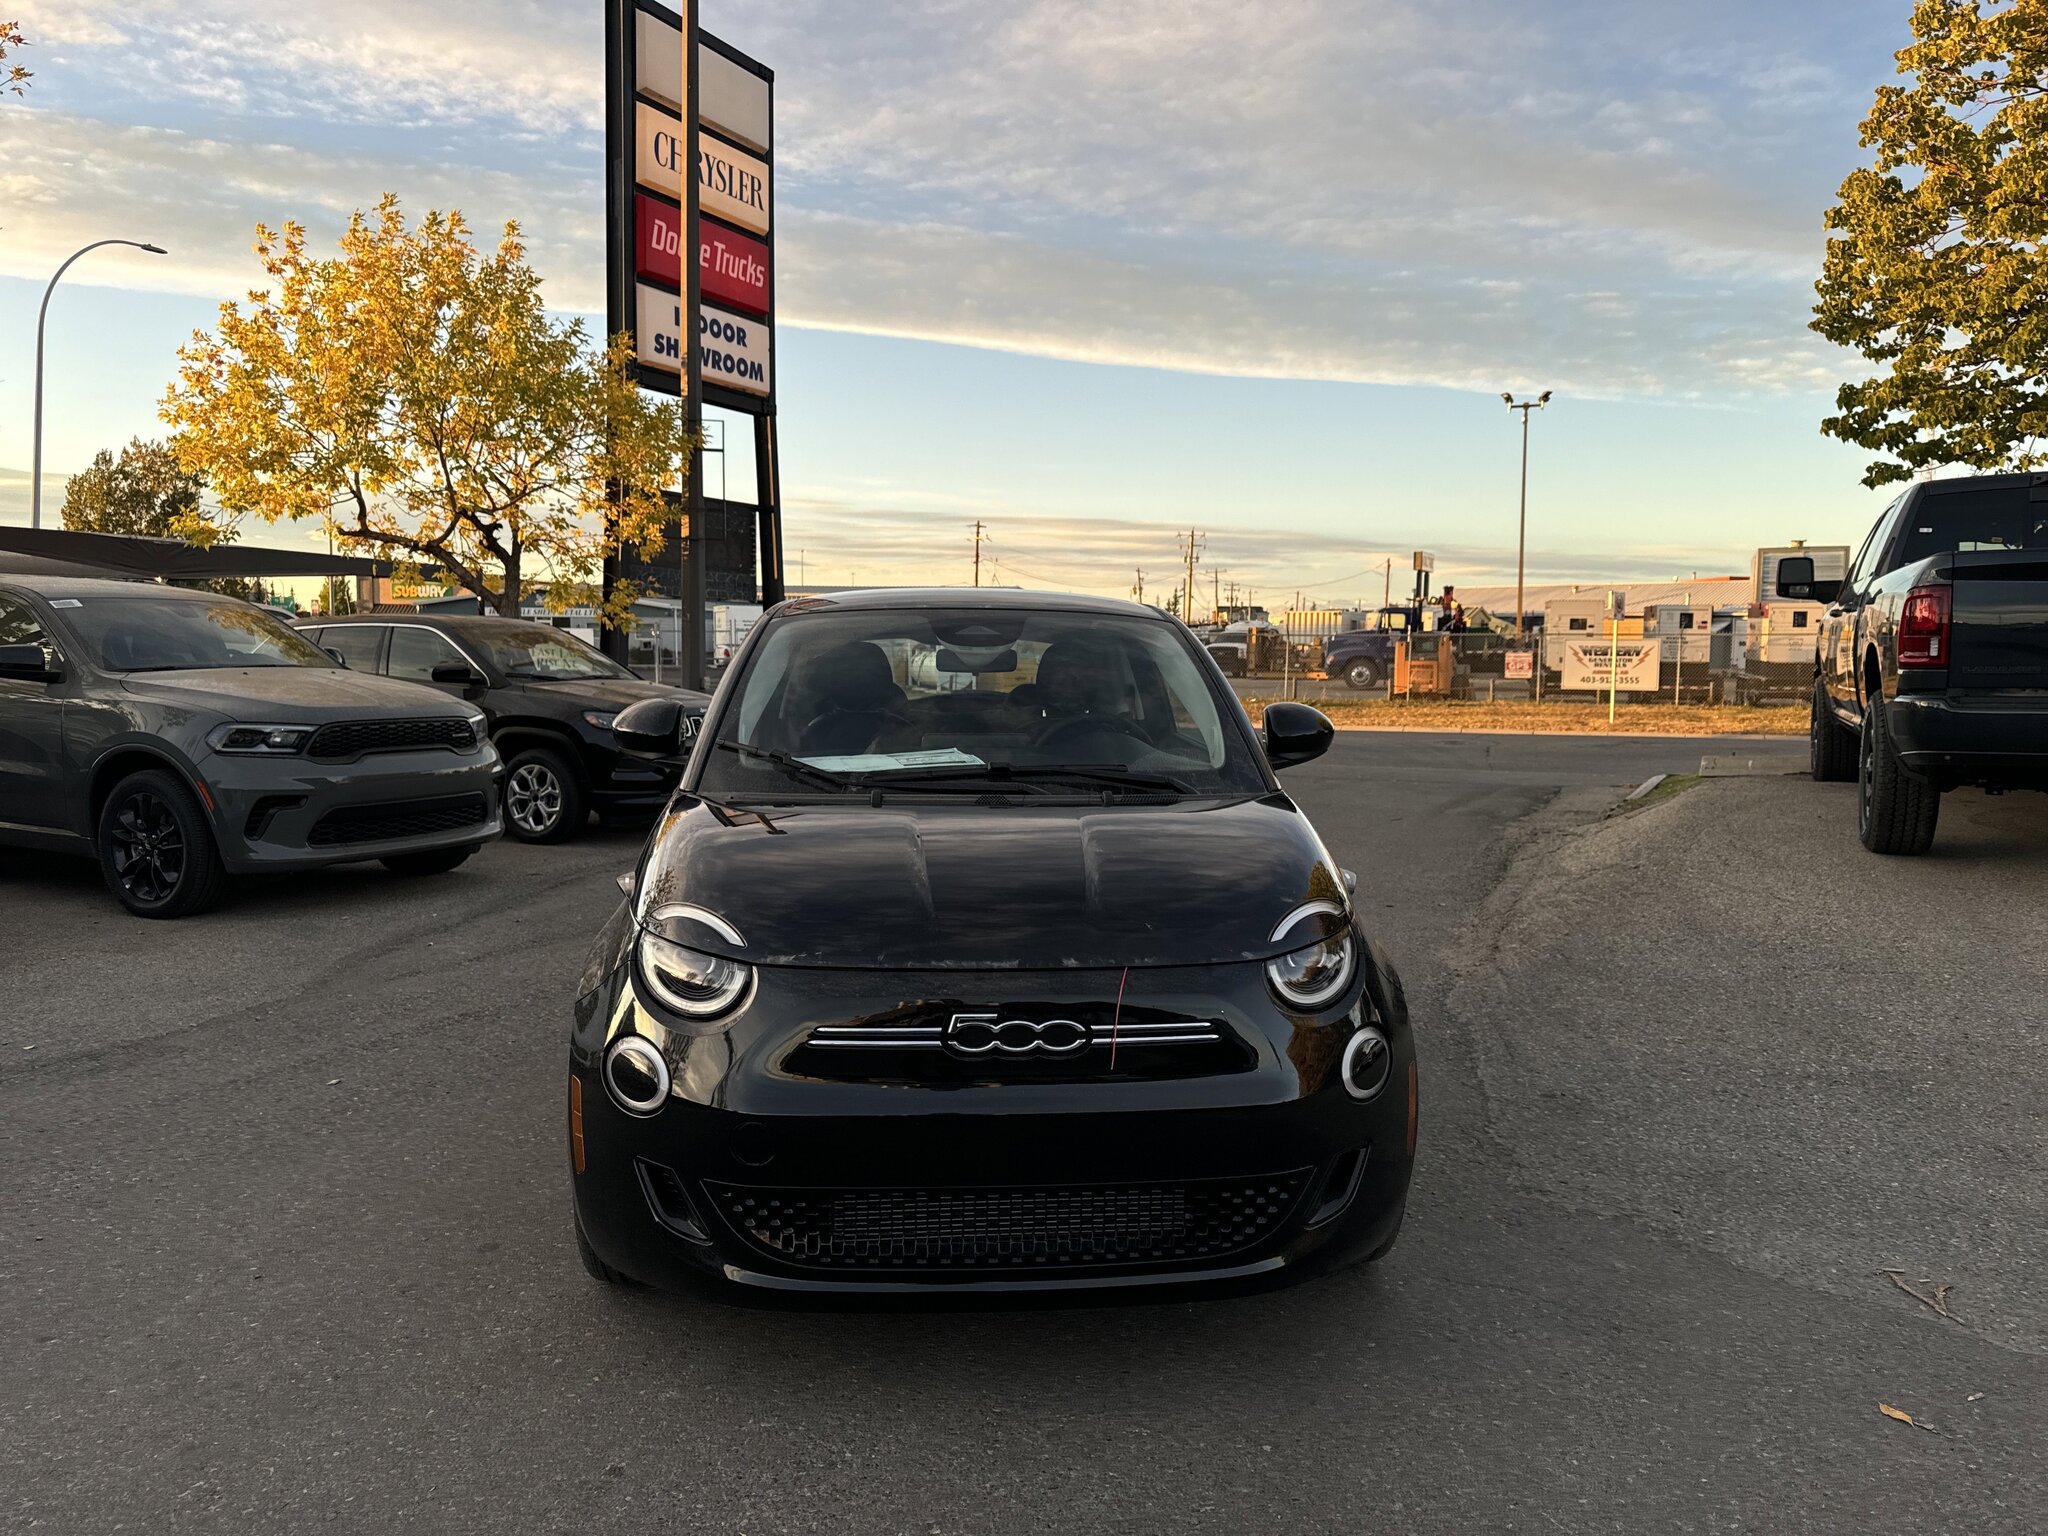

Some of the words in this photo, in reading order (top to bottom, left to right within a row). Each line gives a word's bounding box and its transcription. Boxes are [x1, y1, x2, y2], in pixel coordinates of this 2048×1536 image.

[651, 219, 710, 268] Doe
[714, 241, 765, 288] Trucks
[674, 306, 747, 347] IDOOR
[654, 333, 764, 383] SHWROOM
[394, 585, 447, 598] SUBWAY
[948, 1014, 1086, 1051] 500
